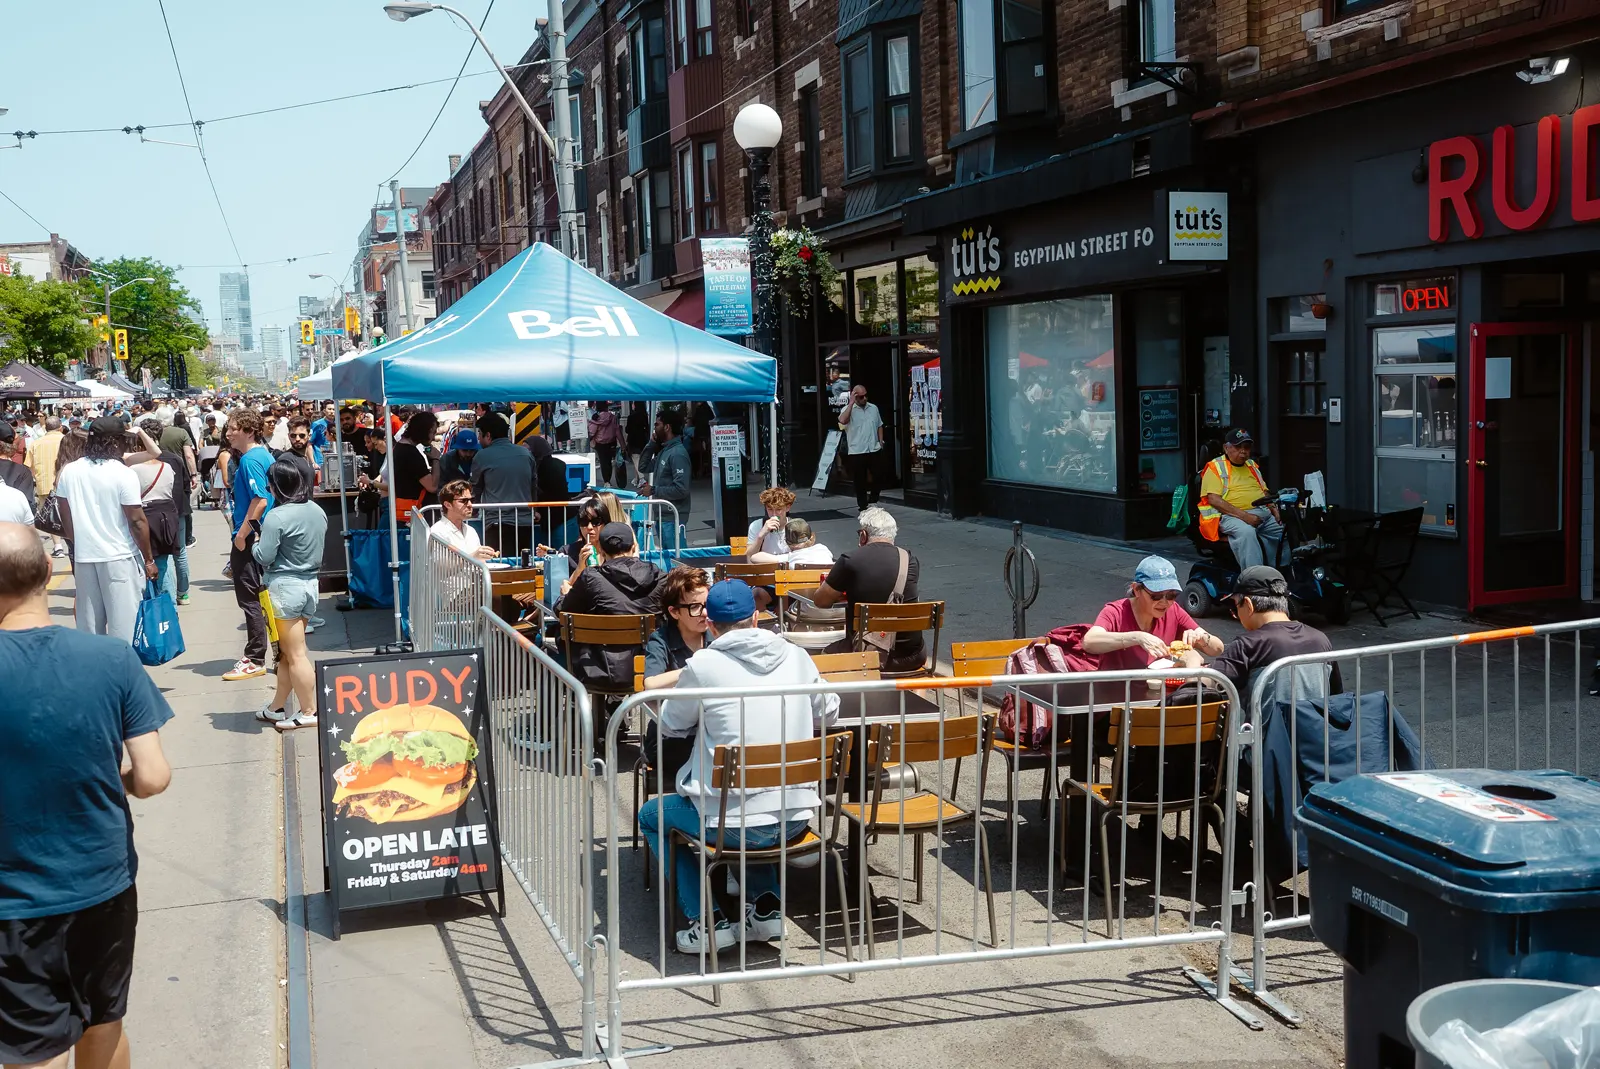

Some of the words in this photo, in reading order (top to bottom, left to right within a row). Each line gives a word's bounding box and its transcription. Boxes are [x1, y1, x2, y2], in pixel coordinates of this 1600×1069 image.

[1014, 241, 1076, 268] EGYPTIAN
[1080, 232, 1128, 258] STREET
[1134, 226, 1154, 247] FO
[708, 274, 735, 284] TASTE
[736, 275, 748, 283] OF
[1402, 285, 1448, 311] OPEN
[508, 306, 639, 340] Bell
[335, 665, 471, 714] RUDY
[342, 832, 417, 860] OPEN
[424, 824, 488, 852] LATE
[347, 874, 387, 888] Friday
[390, 872, 400, 883] &
[401, 866, 458, 883] Saturday
[460, 862, 488, 874] 4am
[370, 858, 430, 874] Thursday
[432, 855, 460, 866] 2am
